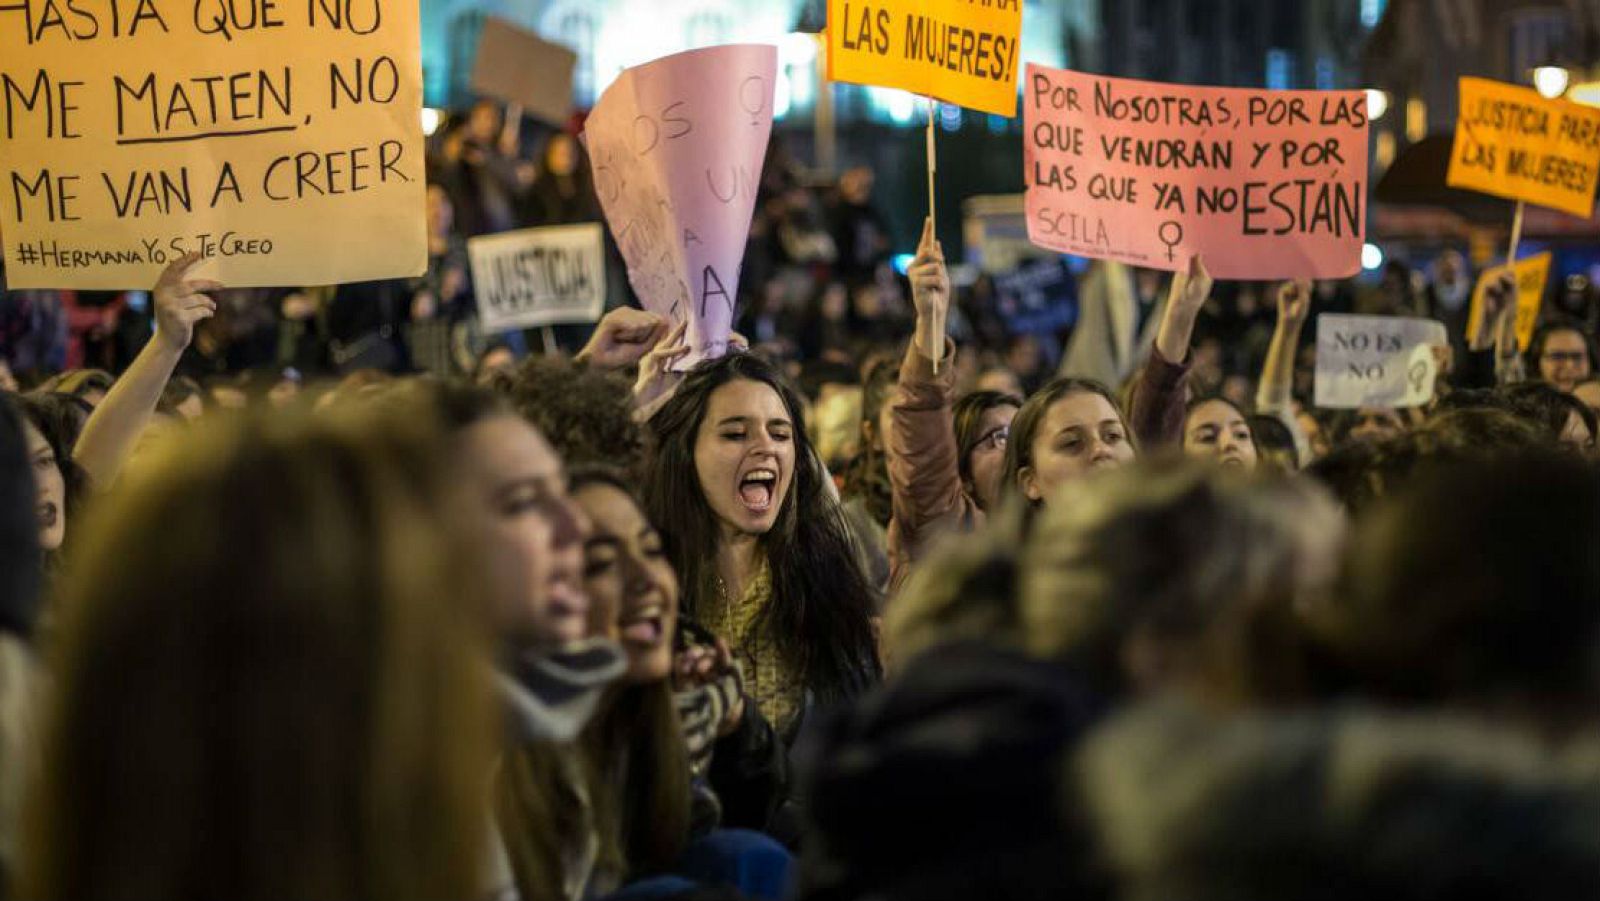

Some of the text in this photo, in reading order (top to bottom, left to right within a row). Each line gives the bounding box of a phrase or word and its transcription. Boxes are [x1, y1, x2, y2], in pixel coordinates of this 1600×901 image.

[193, 0, 285, 41] QUE
[308, 0, 381, 35] NO
[842, 3, 1015, 82] LAS MUJERES!
[1, 56, 400, 139] ME MATEN, NO
[1033, 74, 1366, 128] POR NOSOTRAS, POR LAS
[1033, 121, 1345, 170] QUE VENDRÁN Y POR
[11, 169, 82, 222] ME
[101, 167, 192, 218] VAN
[210, 162, 243, 208] A
[1035, 161, 1360, 238] LAS QUE YA NO ESTÁN
[1037, 207, 1111, 248] SCILA
[701, 265, 733, 317] A
